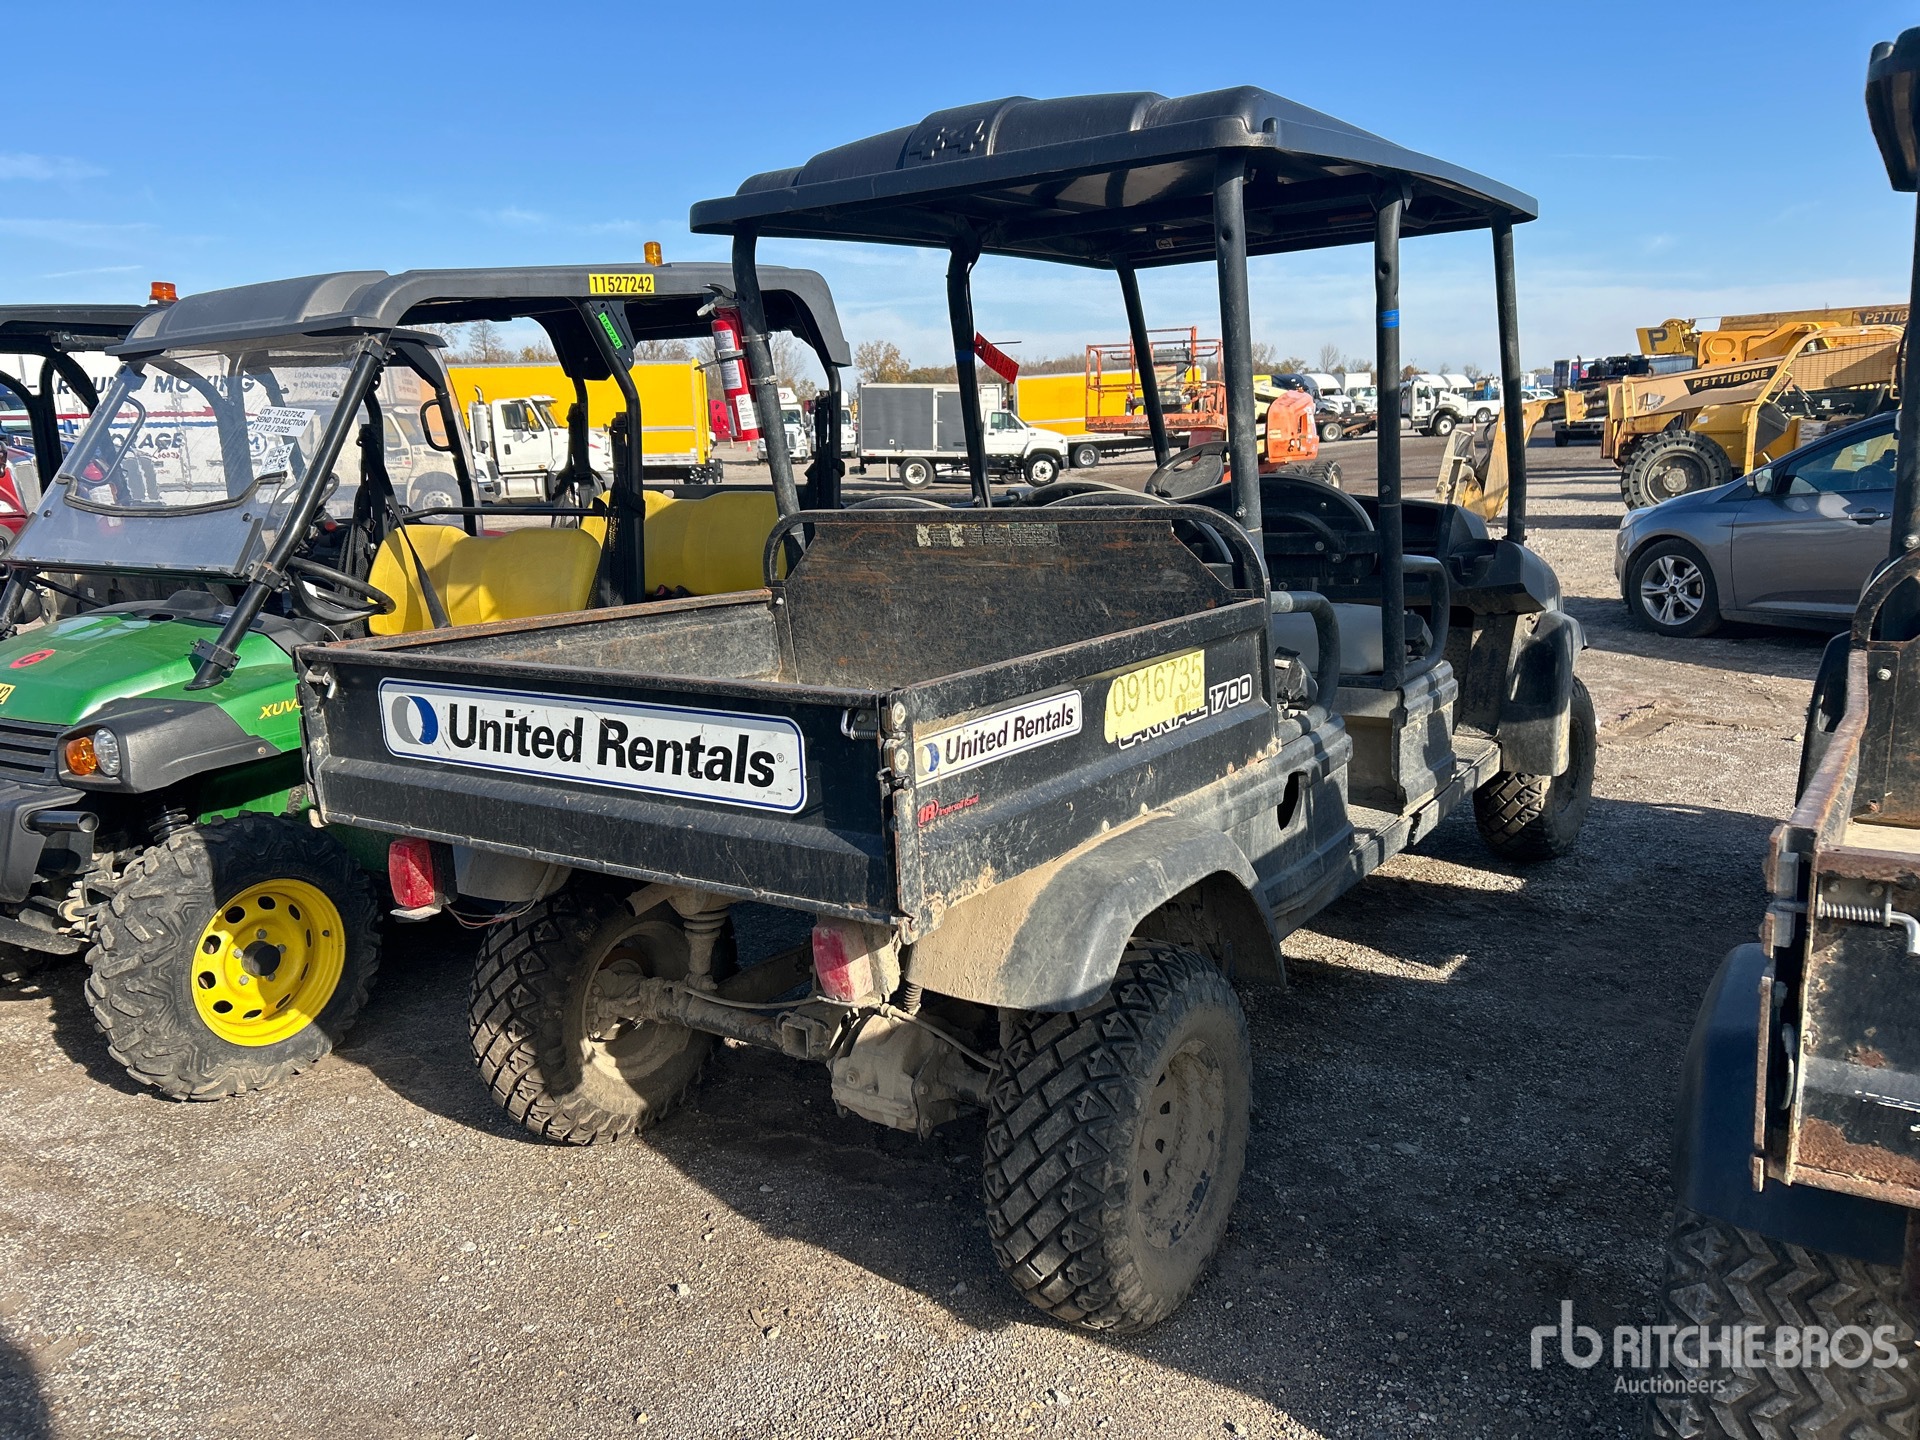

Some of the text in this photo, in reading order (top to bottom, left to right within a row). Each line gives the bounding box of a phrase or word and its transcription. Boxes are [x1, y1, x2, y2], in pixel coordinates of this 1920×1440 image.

[592, 276, 652, 293] 11527242
[1864, 310, 1909, 323] PETTIB
[1647, 328, 1668, 352] P
[1693, 368, 1768, 389] PETTIBONE
[255, 416, 308, 427] SEND TO AUCTION
[260, 408, 273, 416] UTV
[276, 409, 306, 419] 11527242
[1112, 653, 1202, 717] 0916735
[1209, 673, 1252, 715] 1700
[259, 698, 302, 720] XUV
[945, 720, 1008, 765] United
[1013, 703, 1074, 742] Rentals
[448, 703, 776, 788] United Rentals
